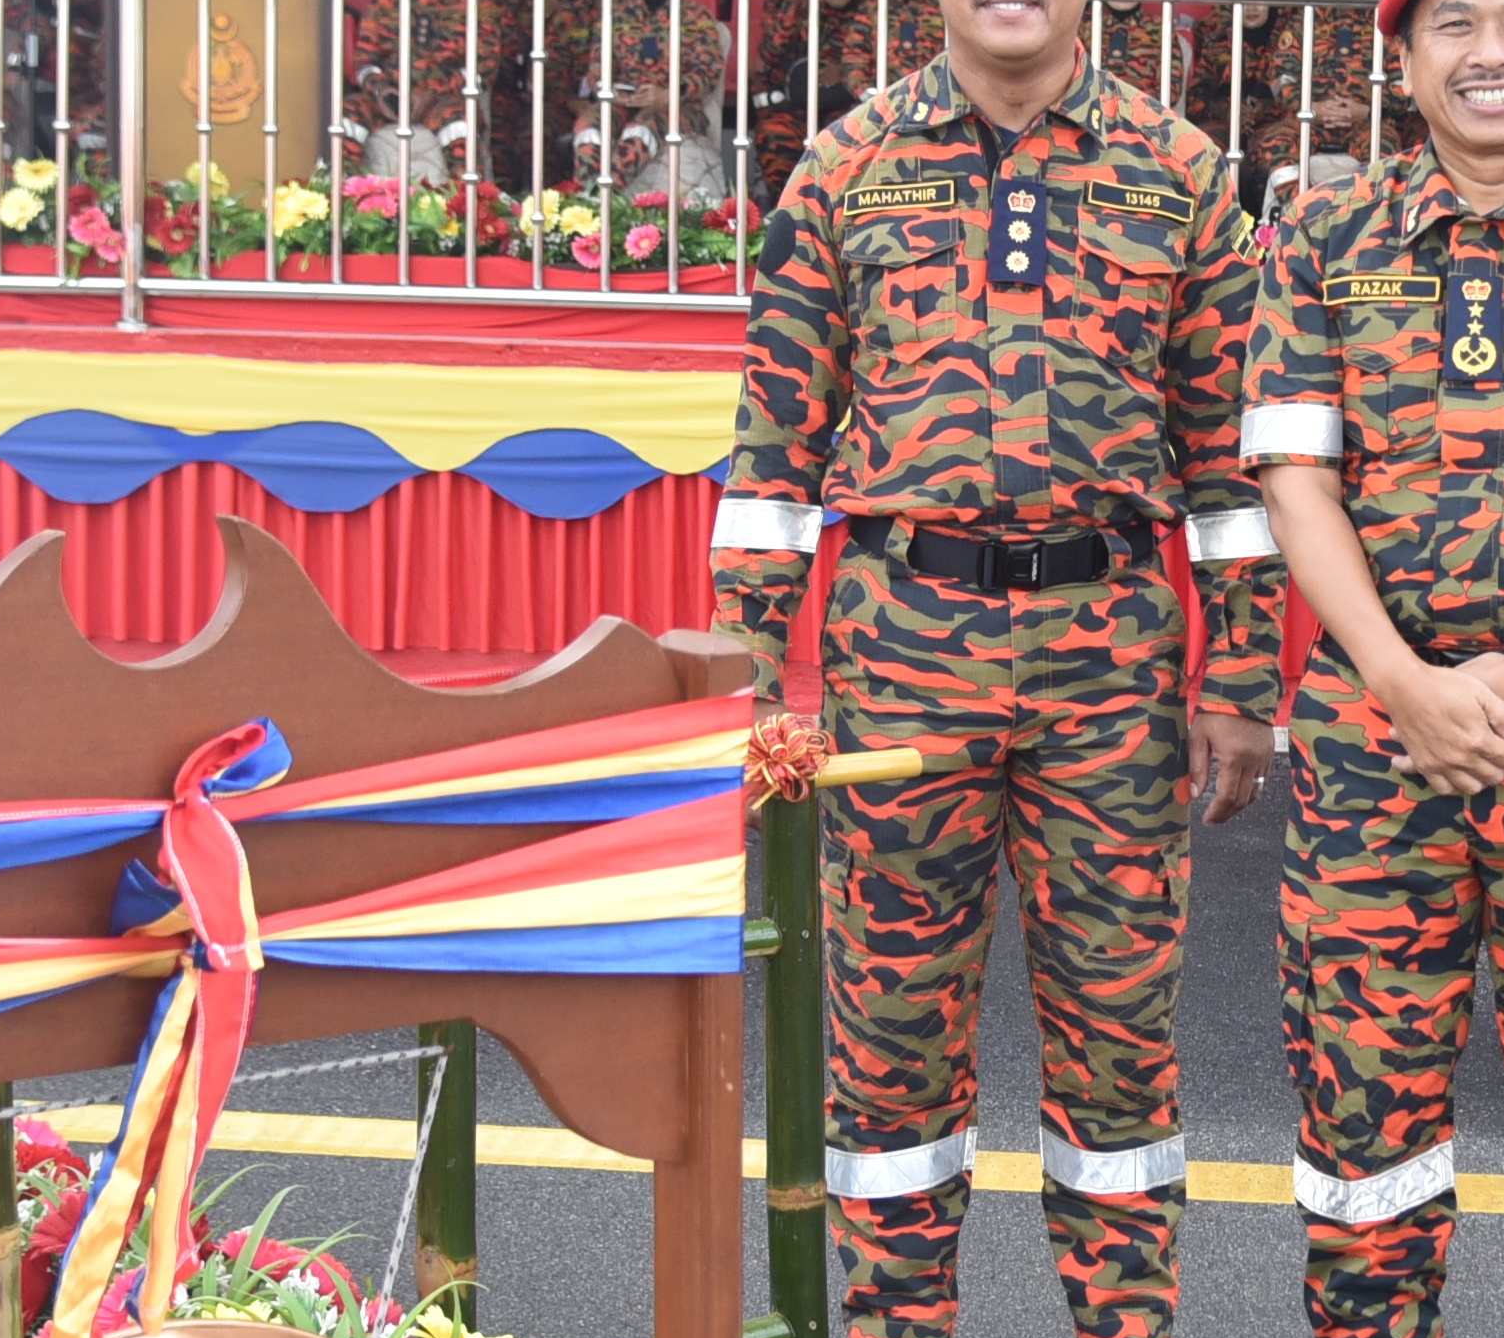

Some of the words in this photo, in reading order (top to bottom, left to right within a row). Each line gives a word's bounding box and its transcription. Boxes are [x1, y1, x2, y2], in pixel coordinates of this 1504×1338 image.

[858, 188, 937, 207] MAHATHIR
[1124, 191, 1161, 208] 13145
[1350, 282, 1402, 296] RAZAK
